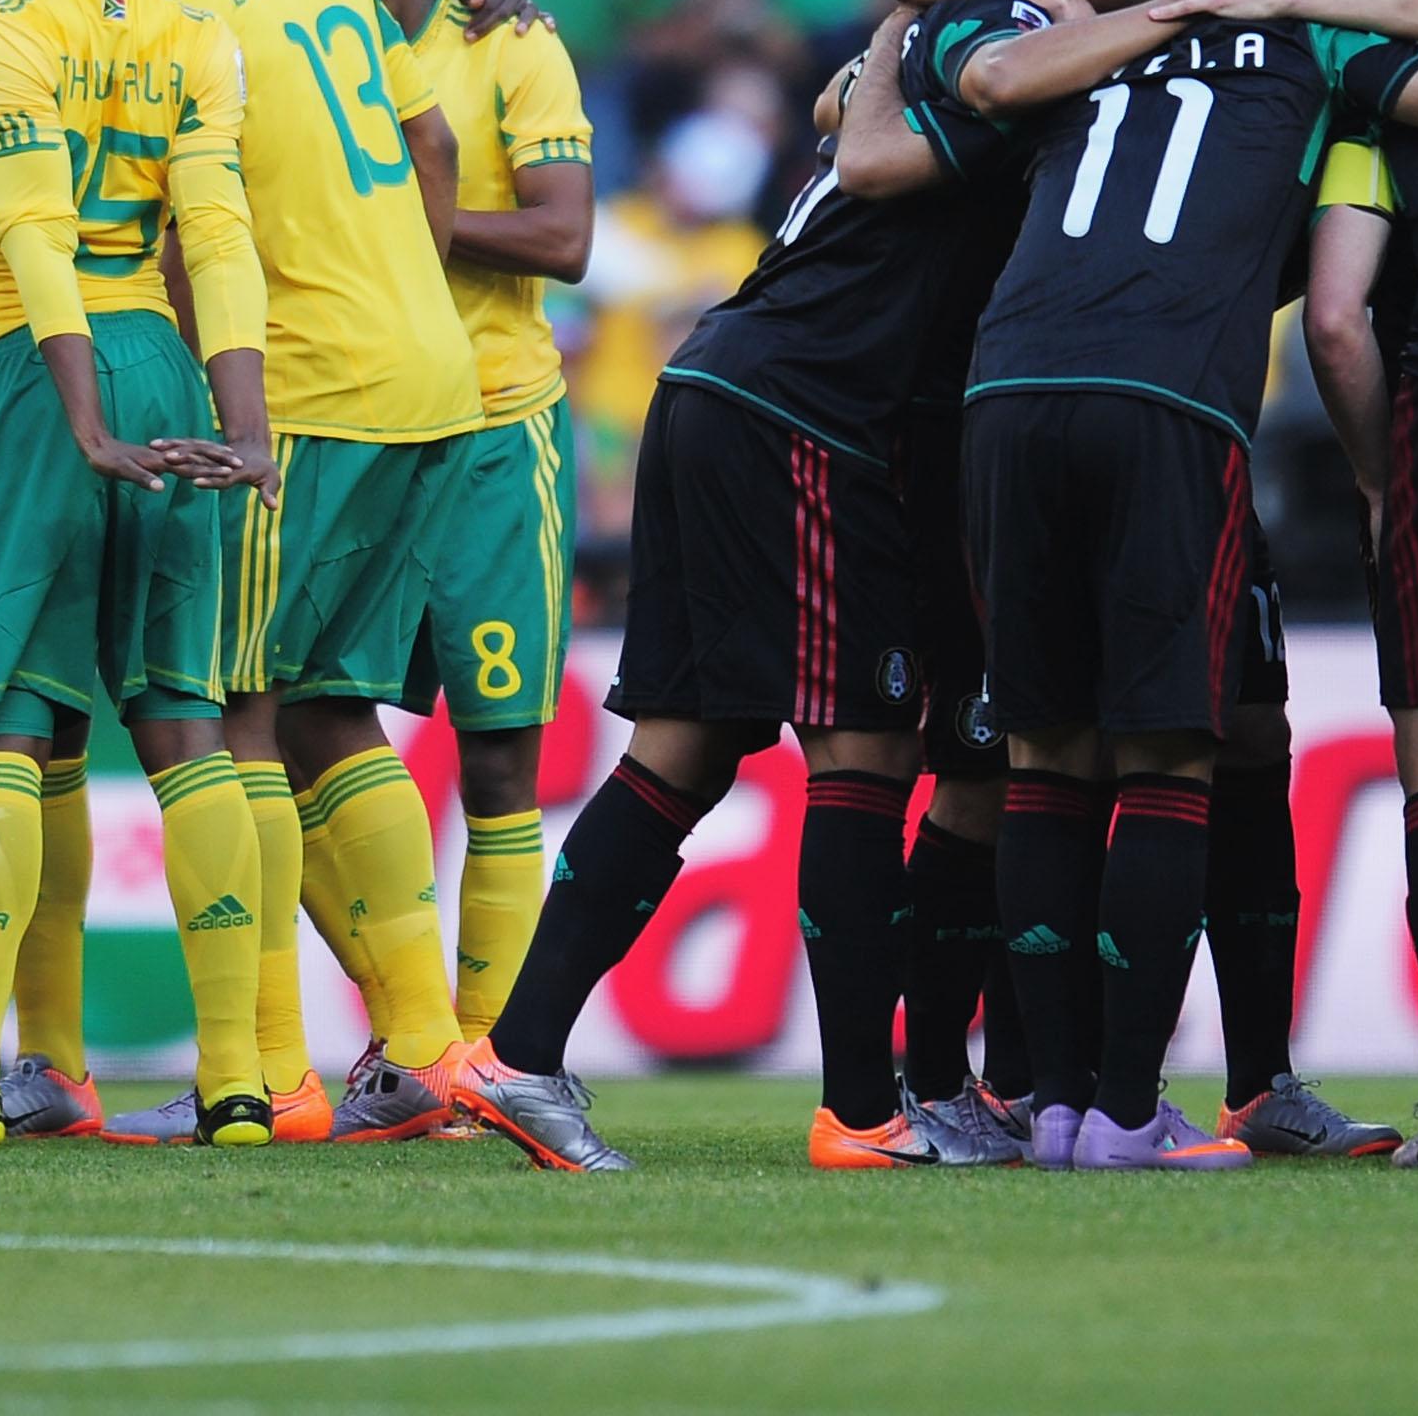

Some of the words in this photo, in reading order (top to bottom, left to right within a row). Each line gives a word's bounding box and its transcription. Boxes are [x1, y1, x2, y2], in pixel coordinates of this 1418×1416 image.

[283, 4, 413, 198] 13
[1062, 76, 1216, 245] 11
[472, 620, 522, 699] 8
[188, 912, 254, 932] adidas
